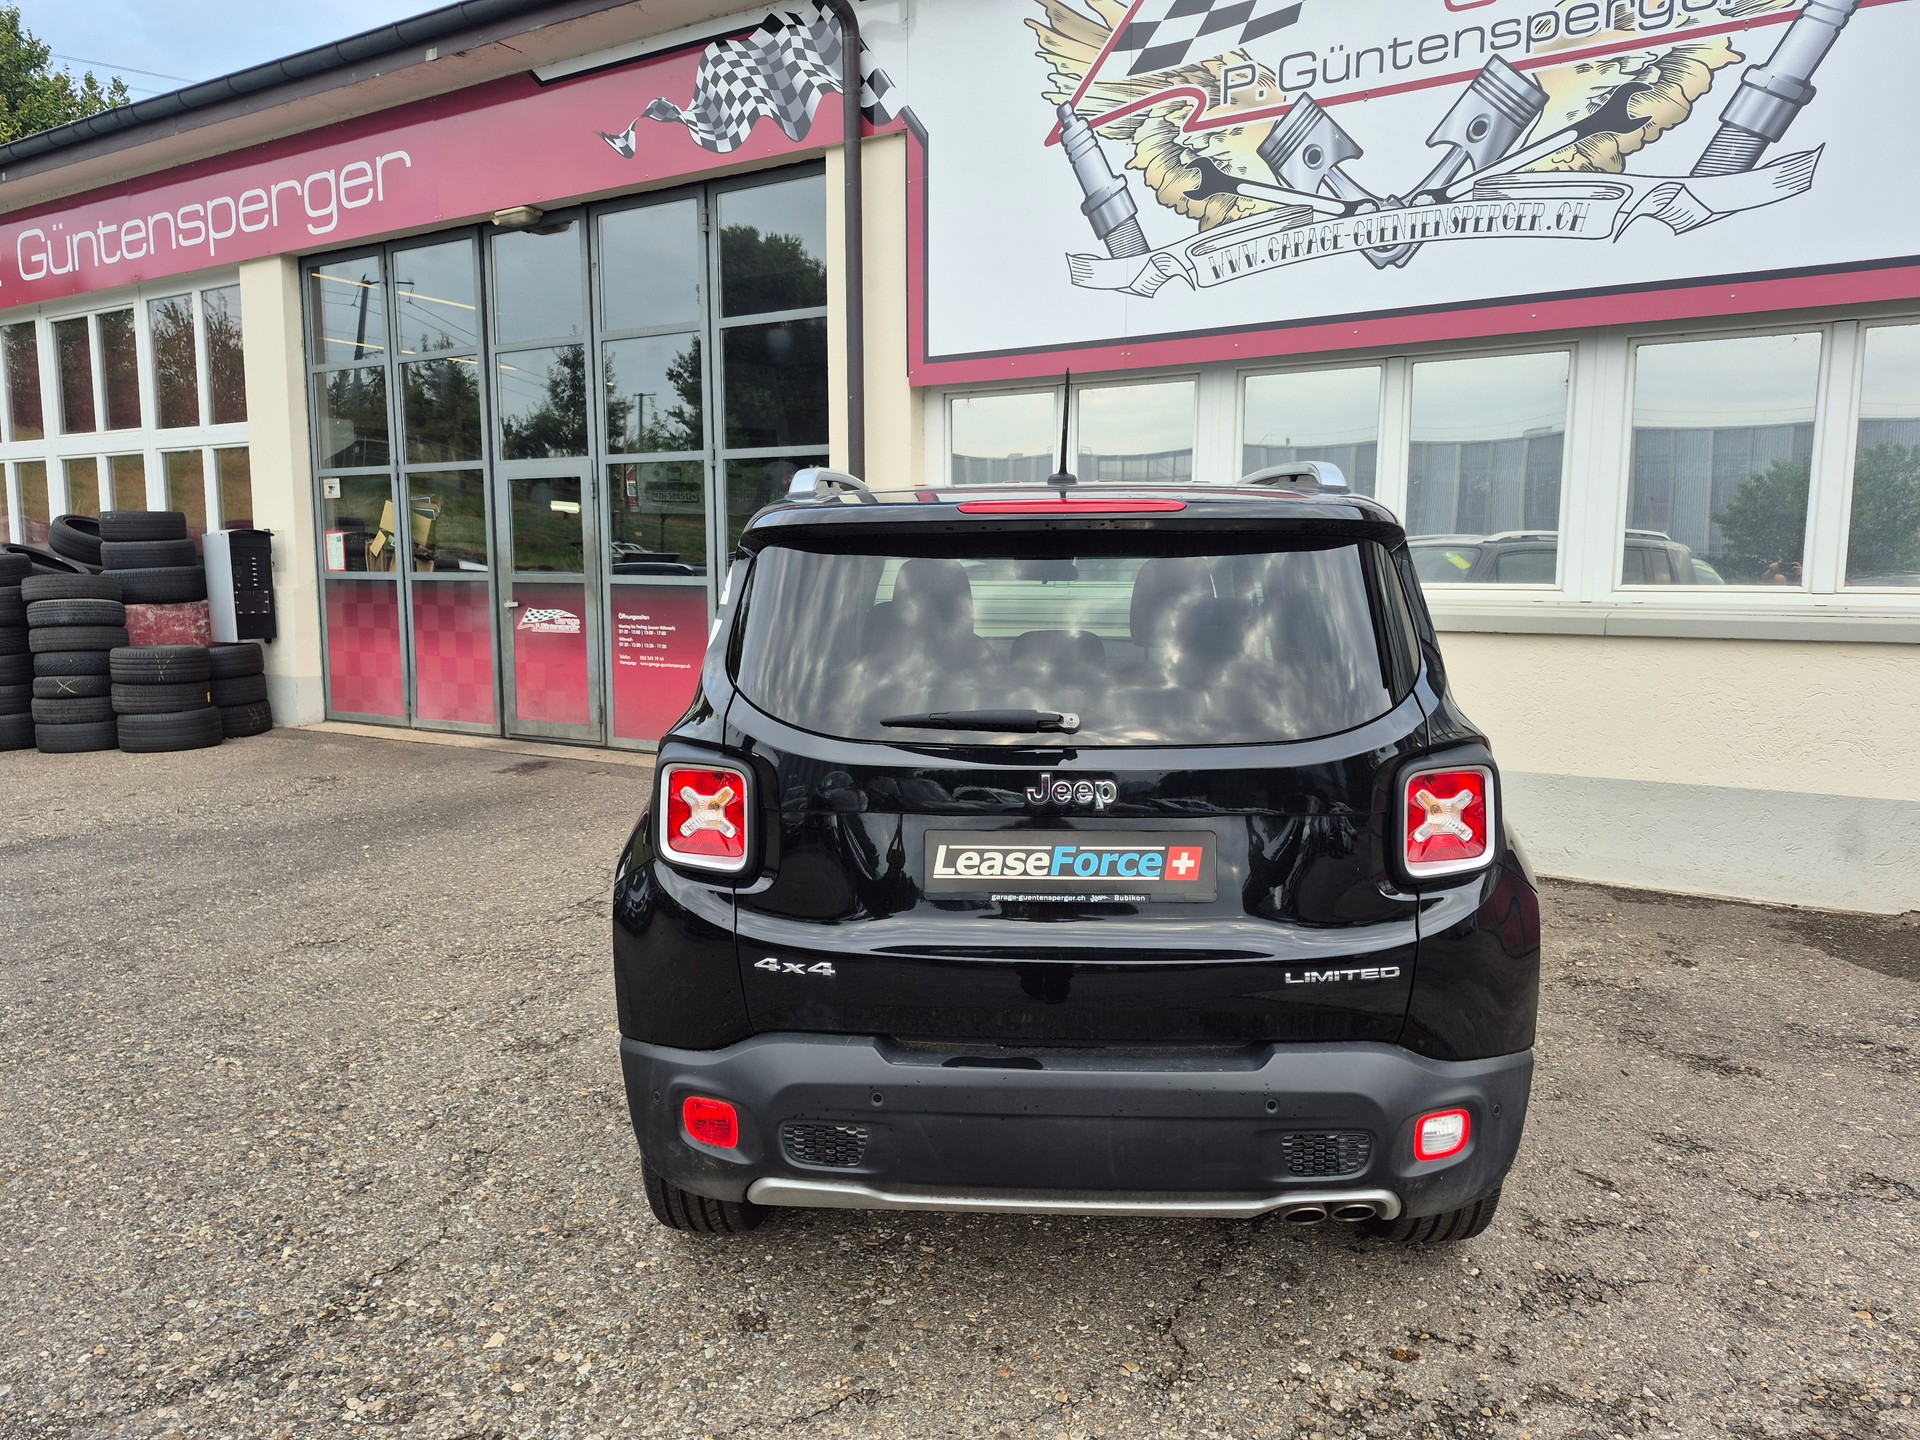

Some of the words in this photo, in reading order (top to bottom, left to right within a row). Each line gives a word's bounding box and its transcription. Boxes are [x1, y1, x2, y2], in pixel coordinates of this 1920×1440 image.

[16, 150, 412, 281] Güntensperger
[1208, 201, 1592, 280] WWW.GARAGE-GUENTENSPERGER.CH
[1026, 773, 1118, 810] Jeep
[933, 844, 1163, 877] LeaseForce
[991, 894, 1086, 902] garage-guentensperger.ch
[754, 957, 836, 976] 4x4
[1285, 966, 1400, 984] LIMITED
